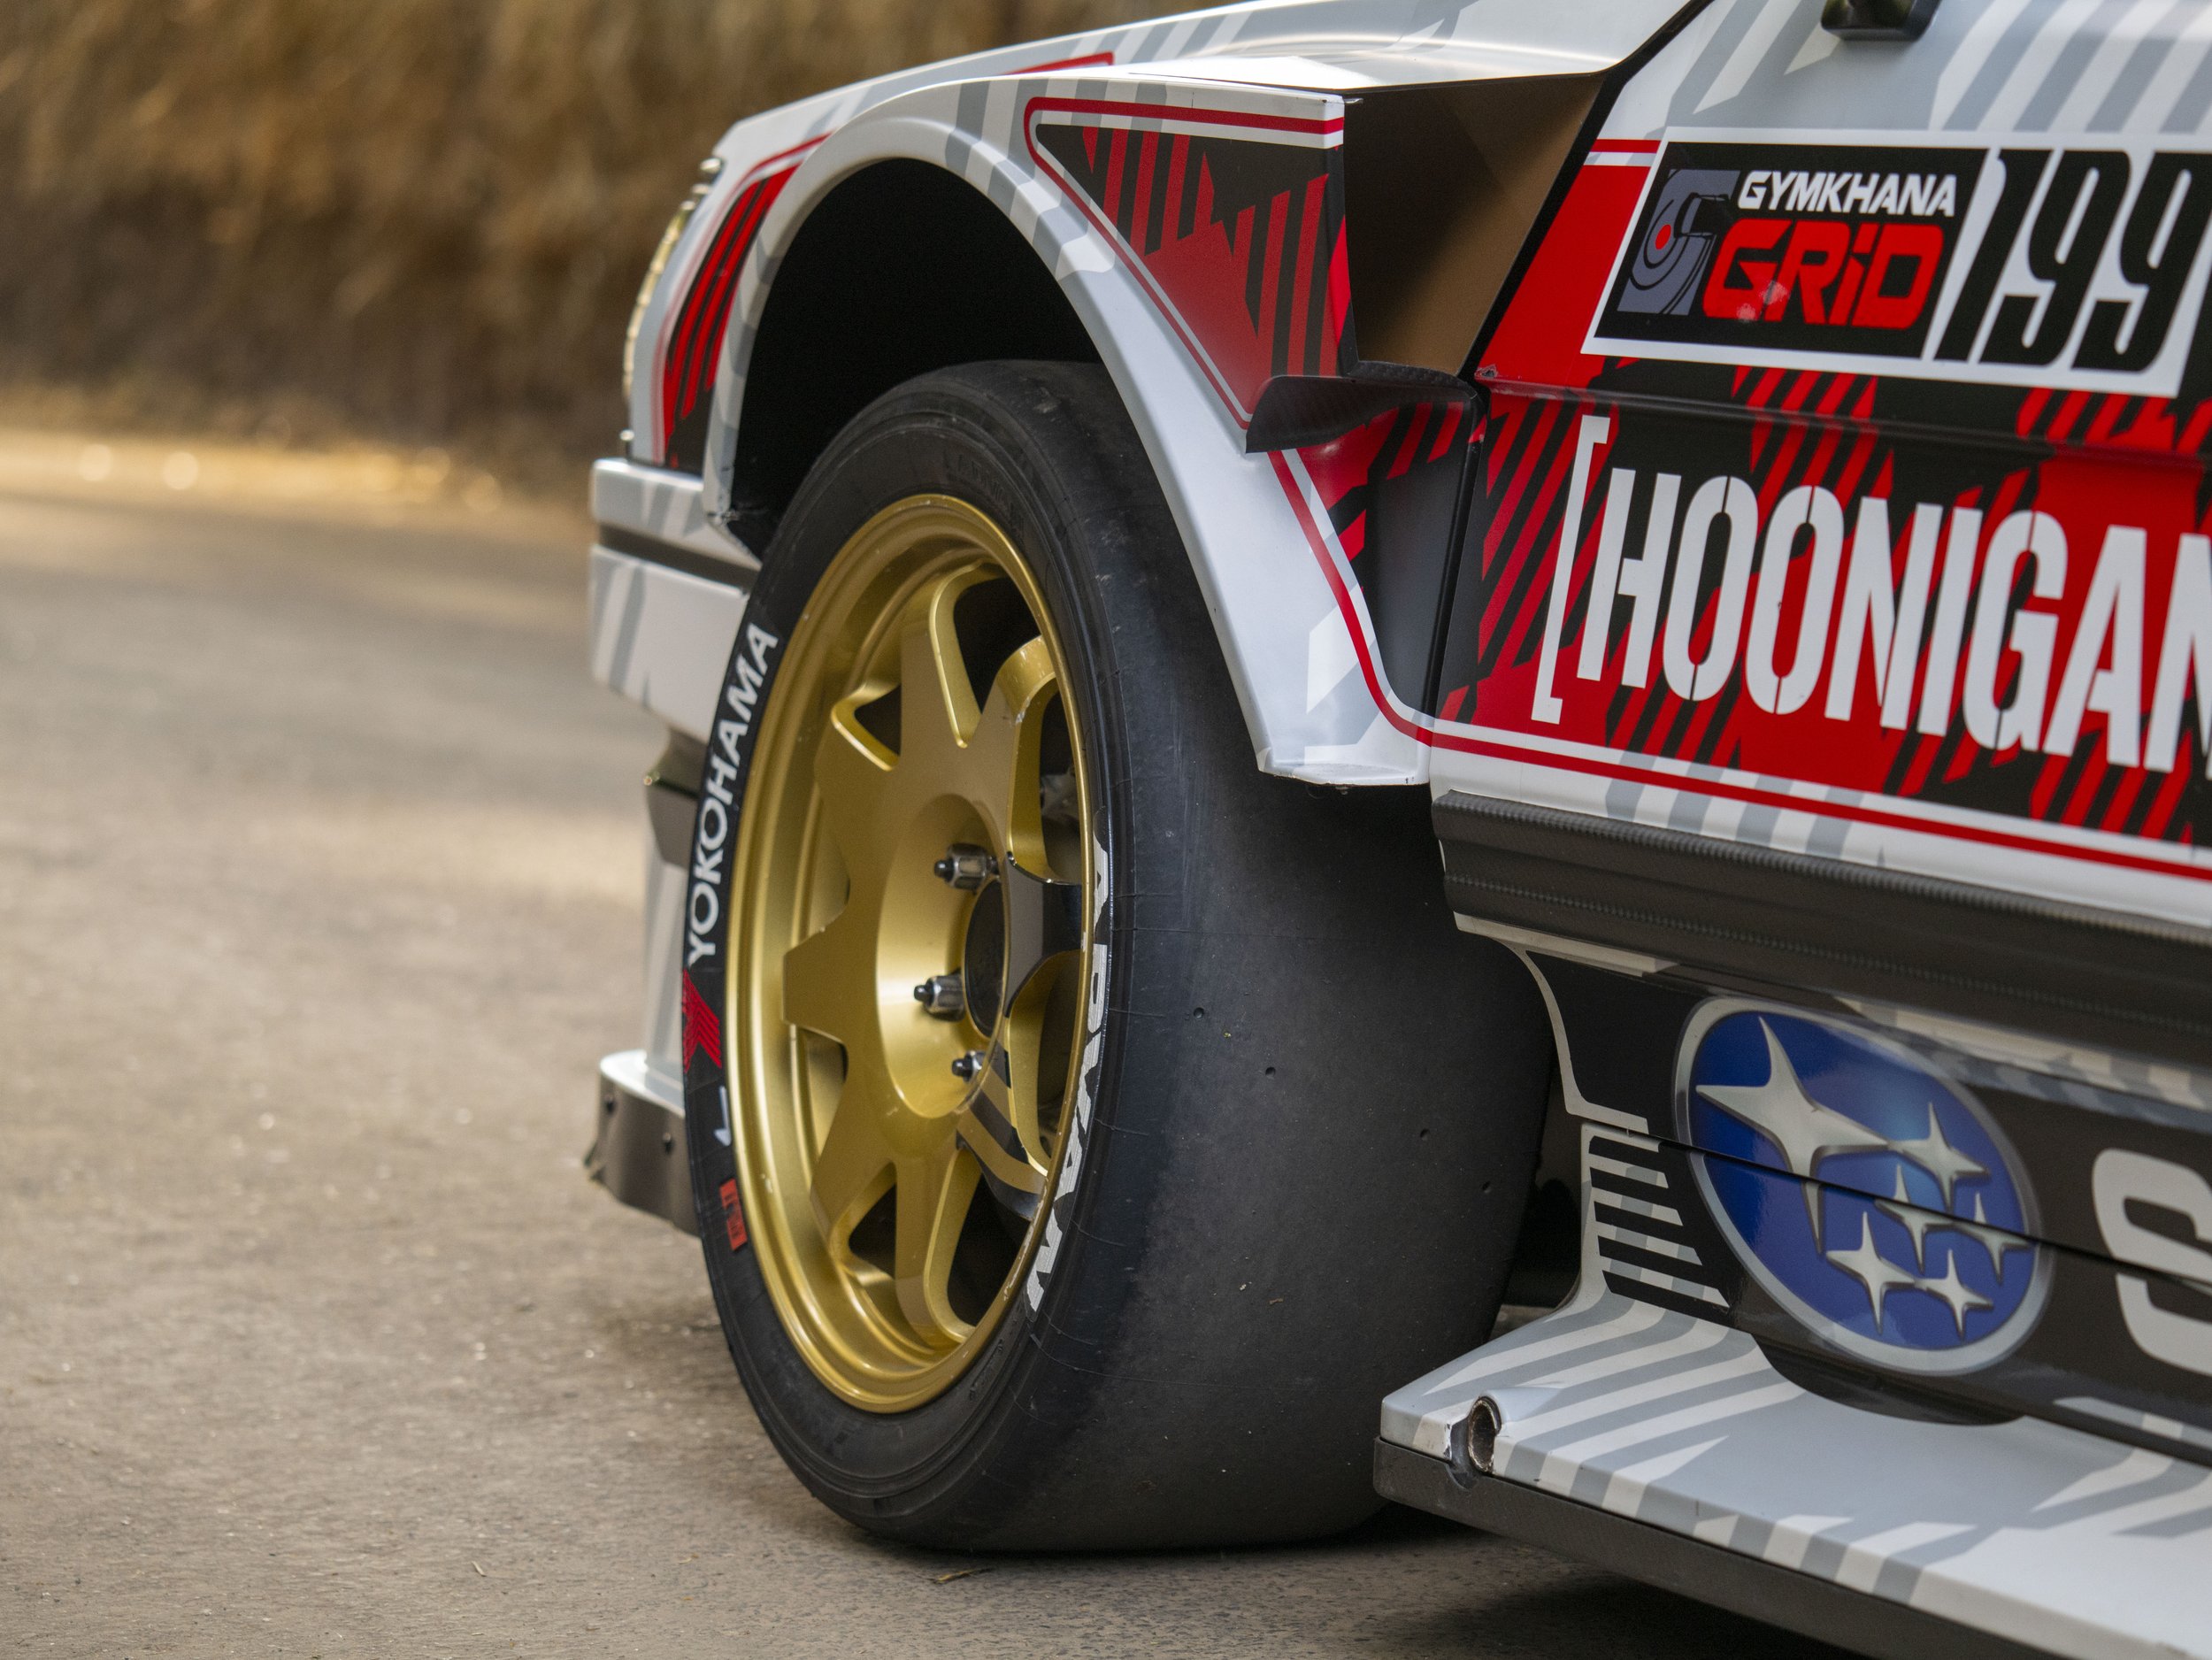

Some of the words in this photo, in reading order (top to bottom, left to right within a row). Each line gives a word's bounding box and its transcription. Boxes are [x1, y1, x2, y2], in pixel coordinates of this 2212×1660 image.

[1738, 171, 1956, 217] GYMKHANA
[1933, 148, 2212, 374] 199
[687, 623, 779, 967] YOKOHAMA
